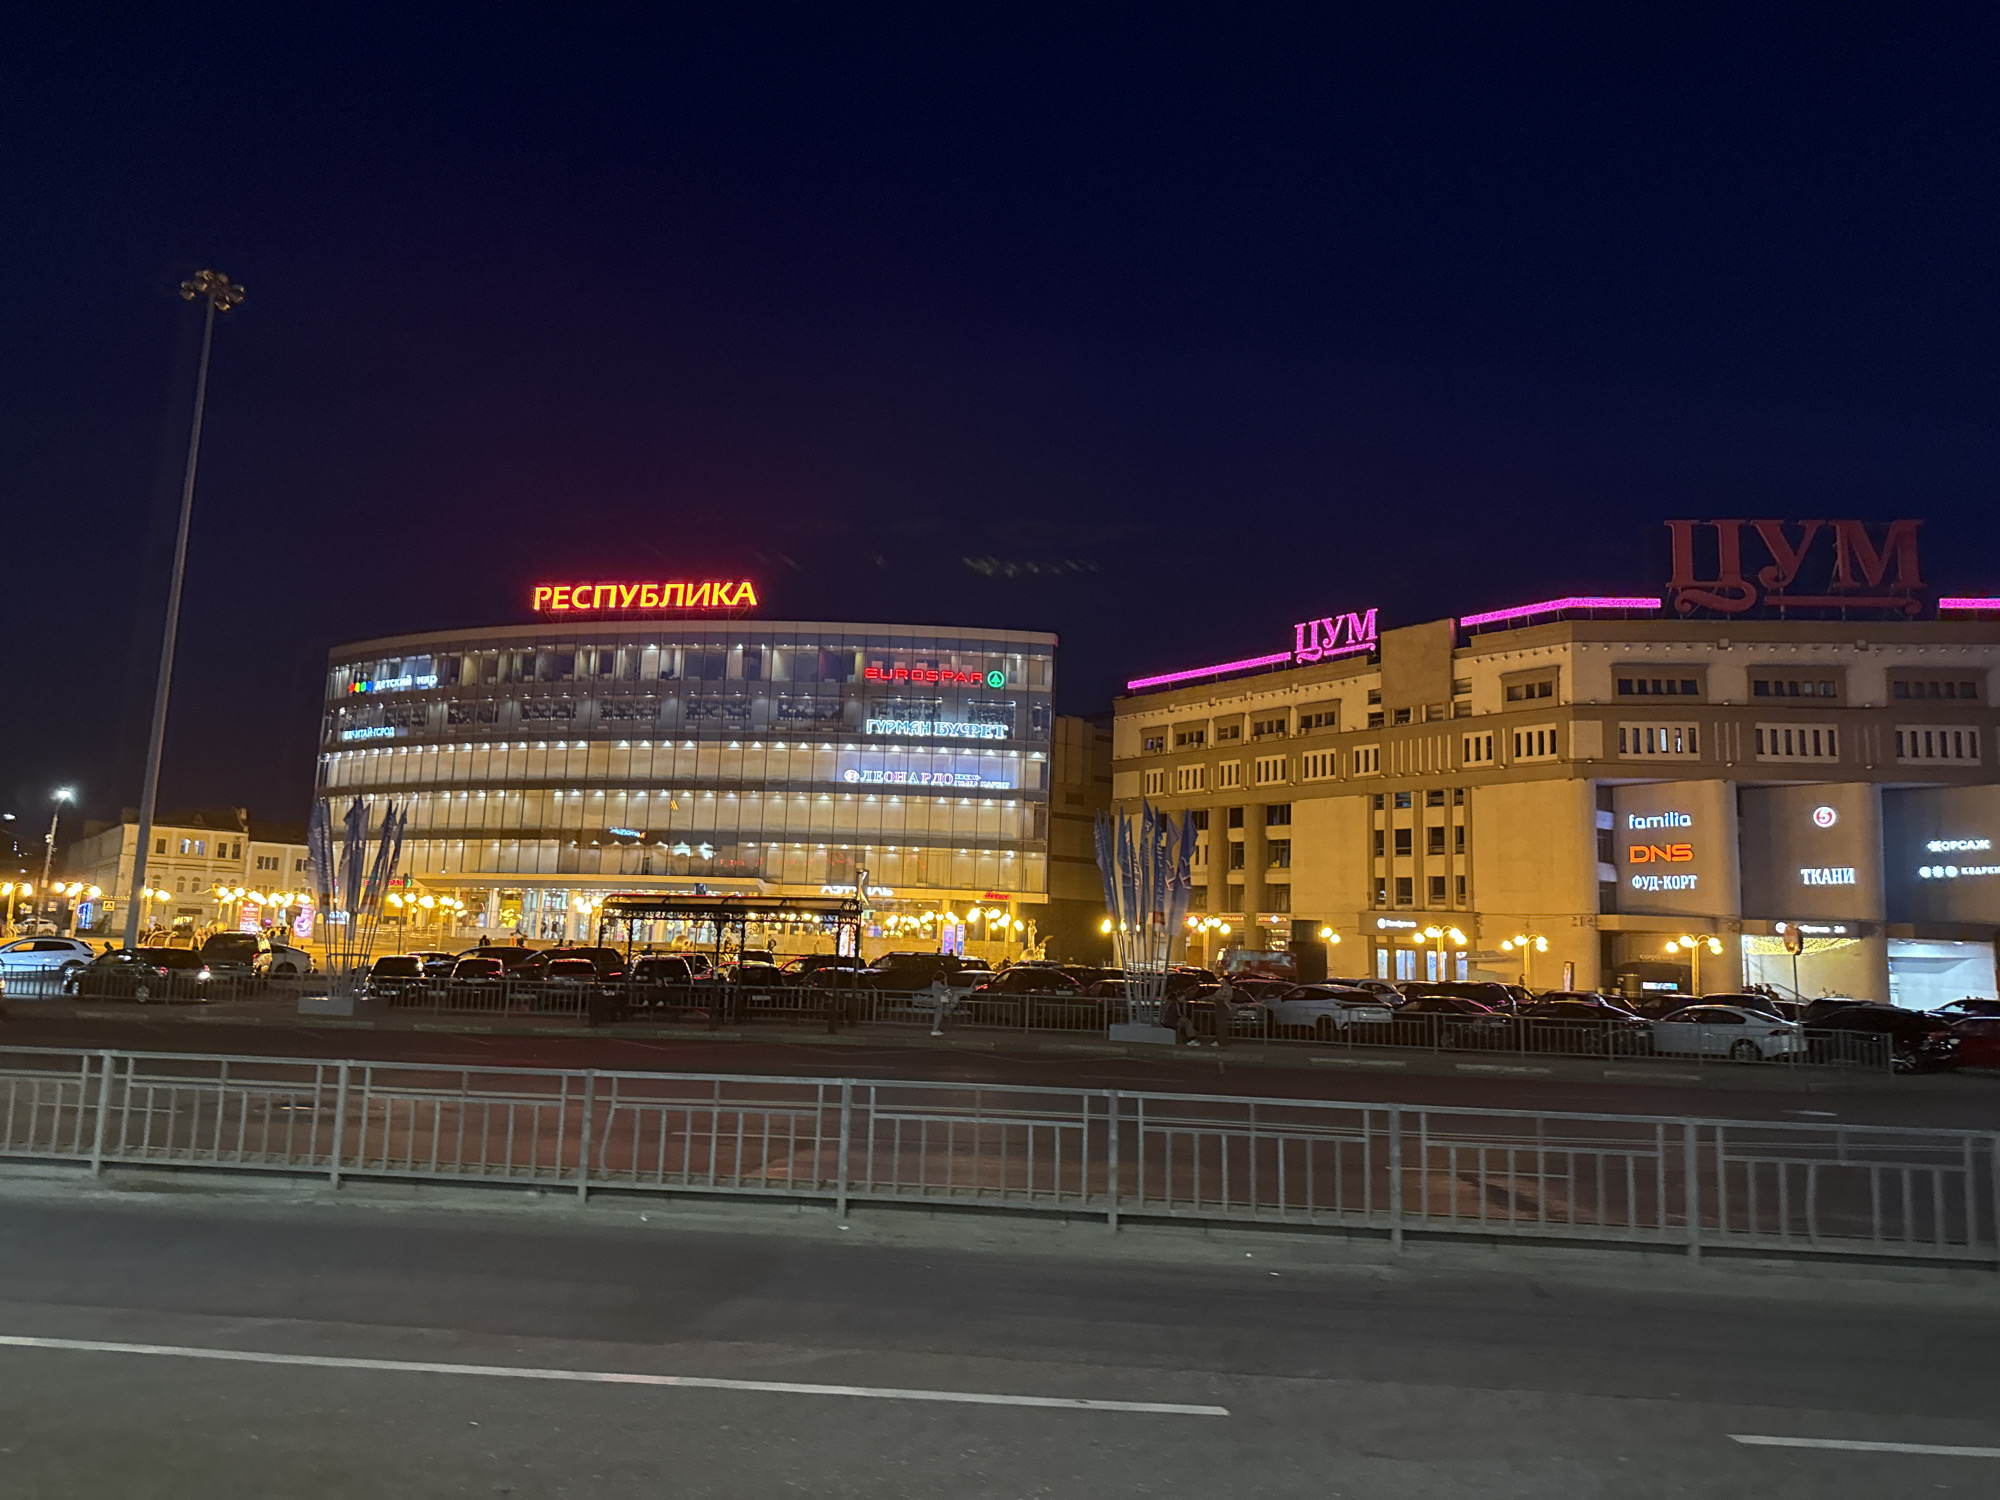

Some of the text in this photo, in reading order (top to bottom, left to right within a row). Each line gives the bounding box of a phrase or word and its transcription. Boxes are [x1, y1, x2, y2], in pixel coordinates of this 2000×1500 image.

[1664, 519, 1927, 614] ЦУМ
[533, 581, 758, 610] РЕСПУБЛИКА
[1294, 608, 1378, 664] ЦУМ
[864, 667, 984, 684] EUROSPAR
[866, 719, 1009, 740] ГУРМАН БУФЕТ
[860, 770, 954, 787] ЛЕОНАРДО
[1628, 811, 1692, 830] familia
[1629, 843, 1694, 864] DNS
[1631, 874, 1697, 892] ФУД-КОРТ
[1800, 867, 1856, 886] ТКАНИ
